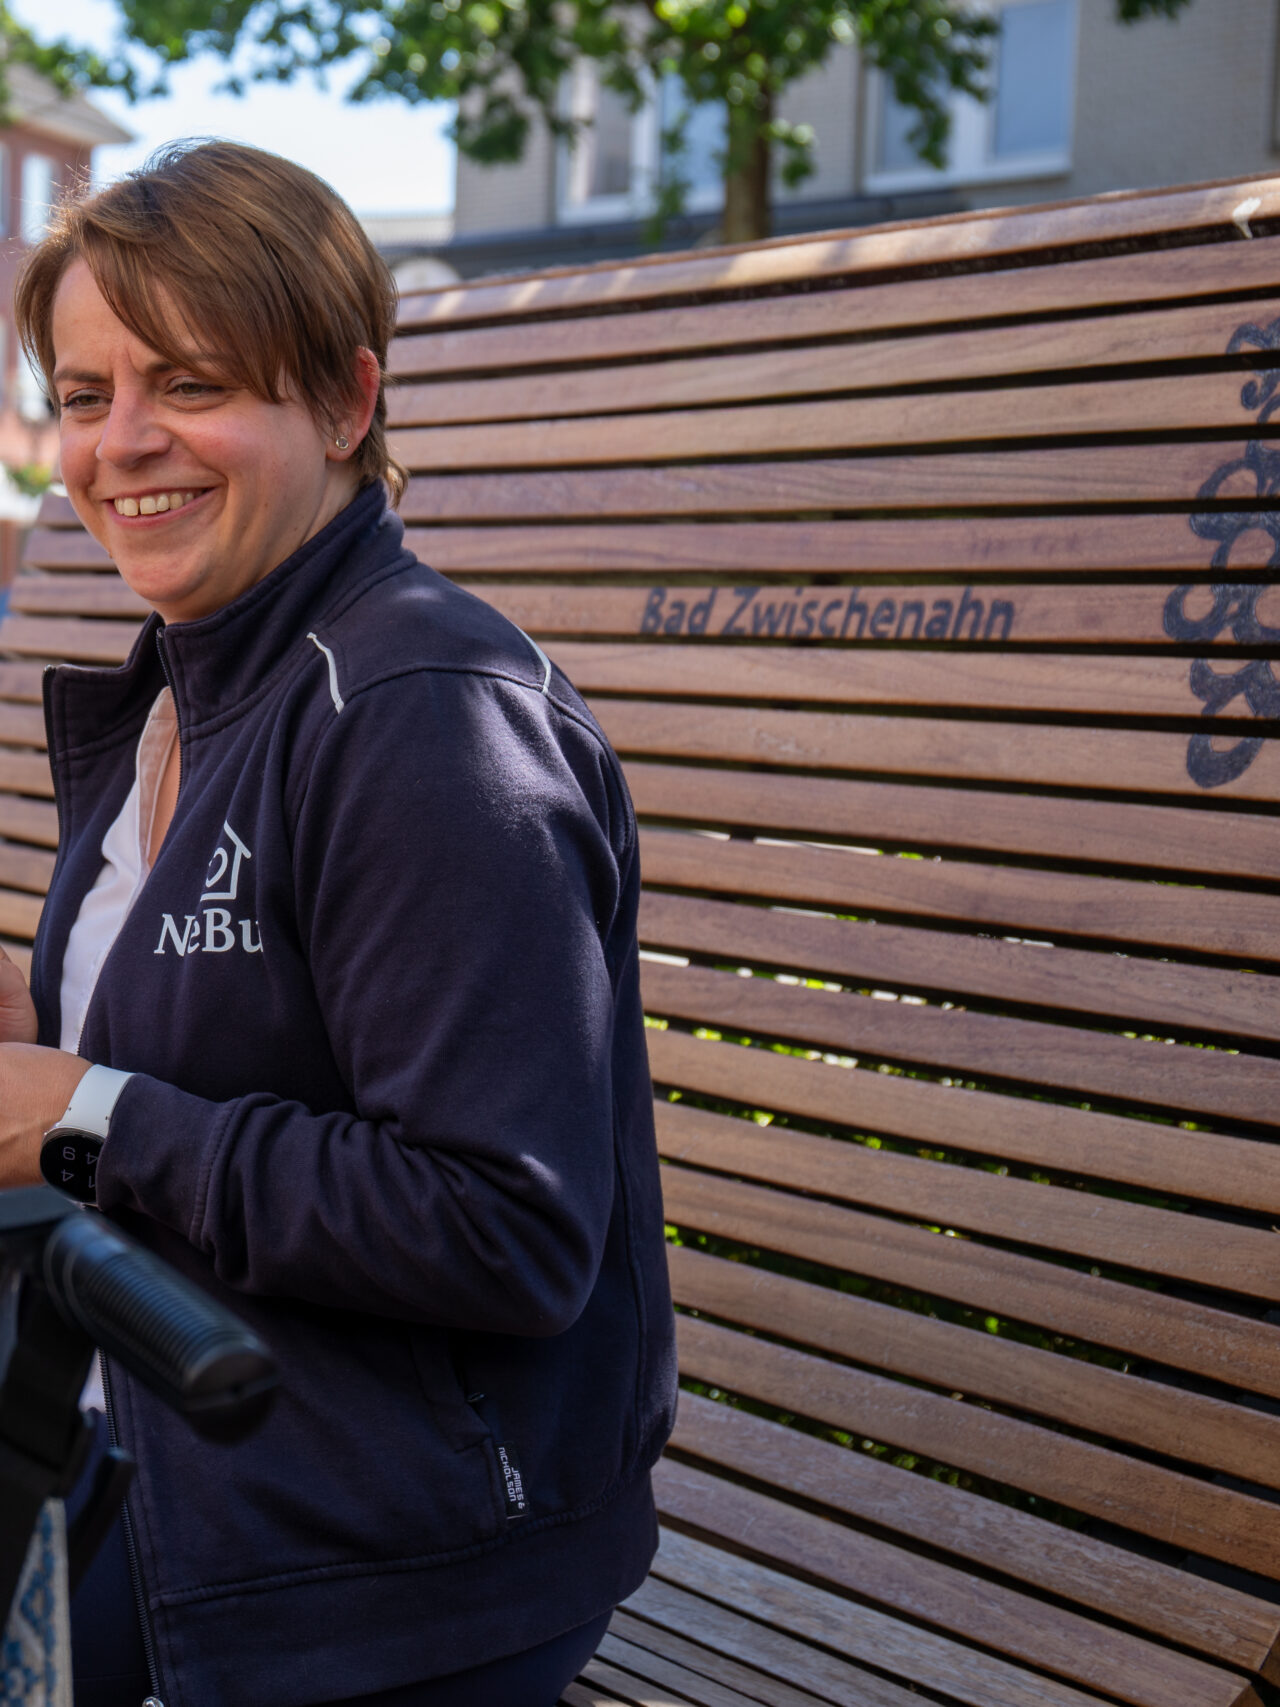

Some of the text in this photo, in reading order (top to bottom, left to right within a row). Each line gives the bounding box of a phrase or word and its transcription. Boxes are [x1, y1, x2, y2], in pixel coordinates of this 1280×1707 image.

[639, 586, 1016, 640] Bad Zwischenahn
[498, 1447, 516, 1501] NICHOLSON
[511, 1467, 524, 1501] JAMES
